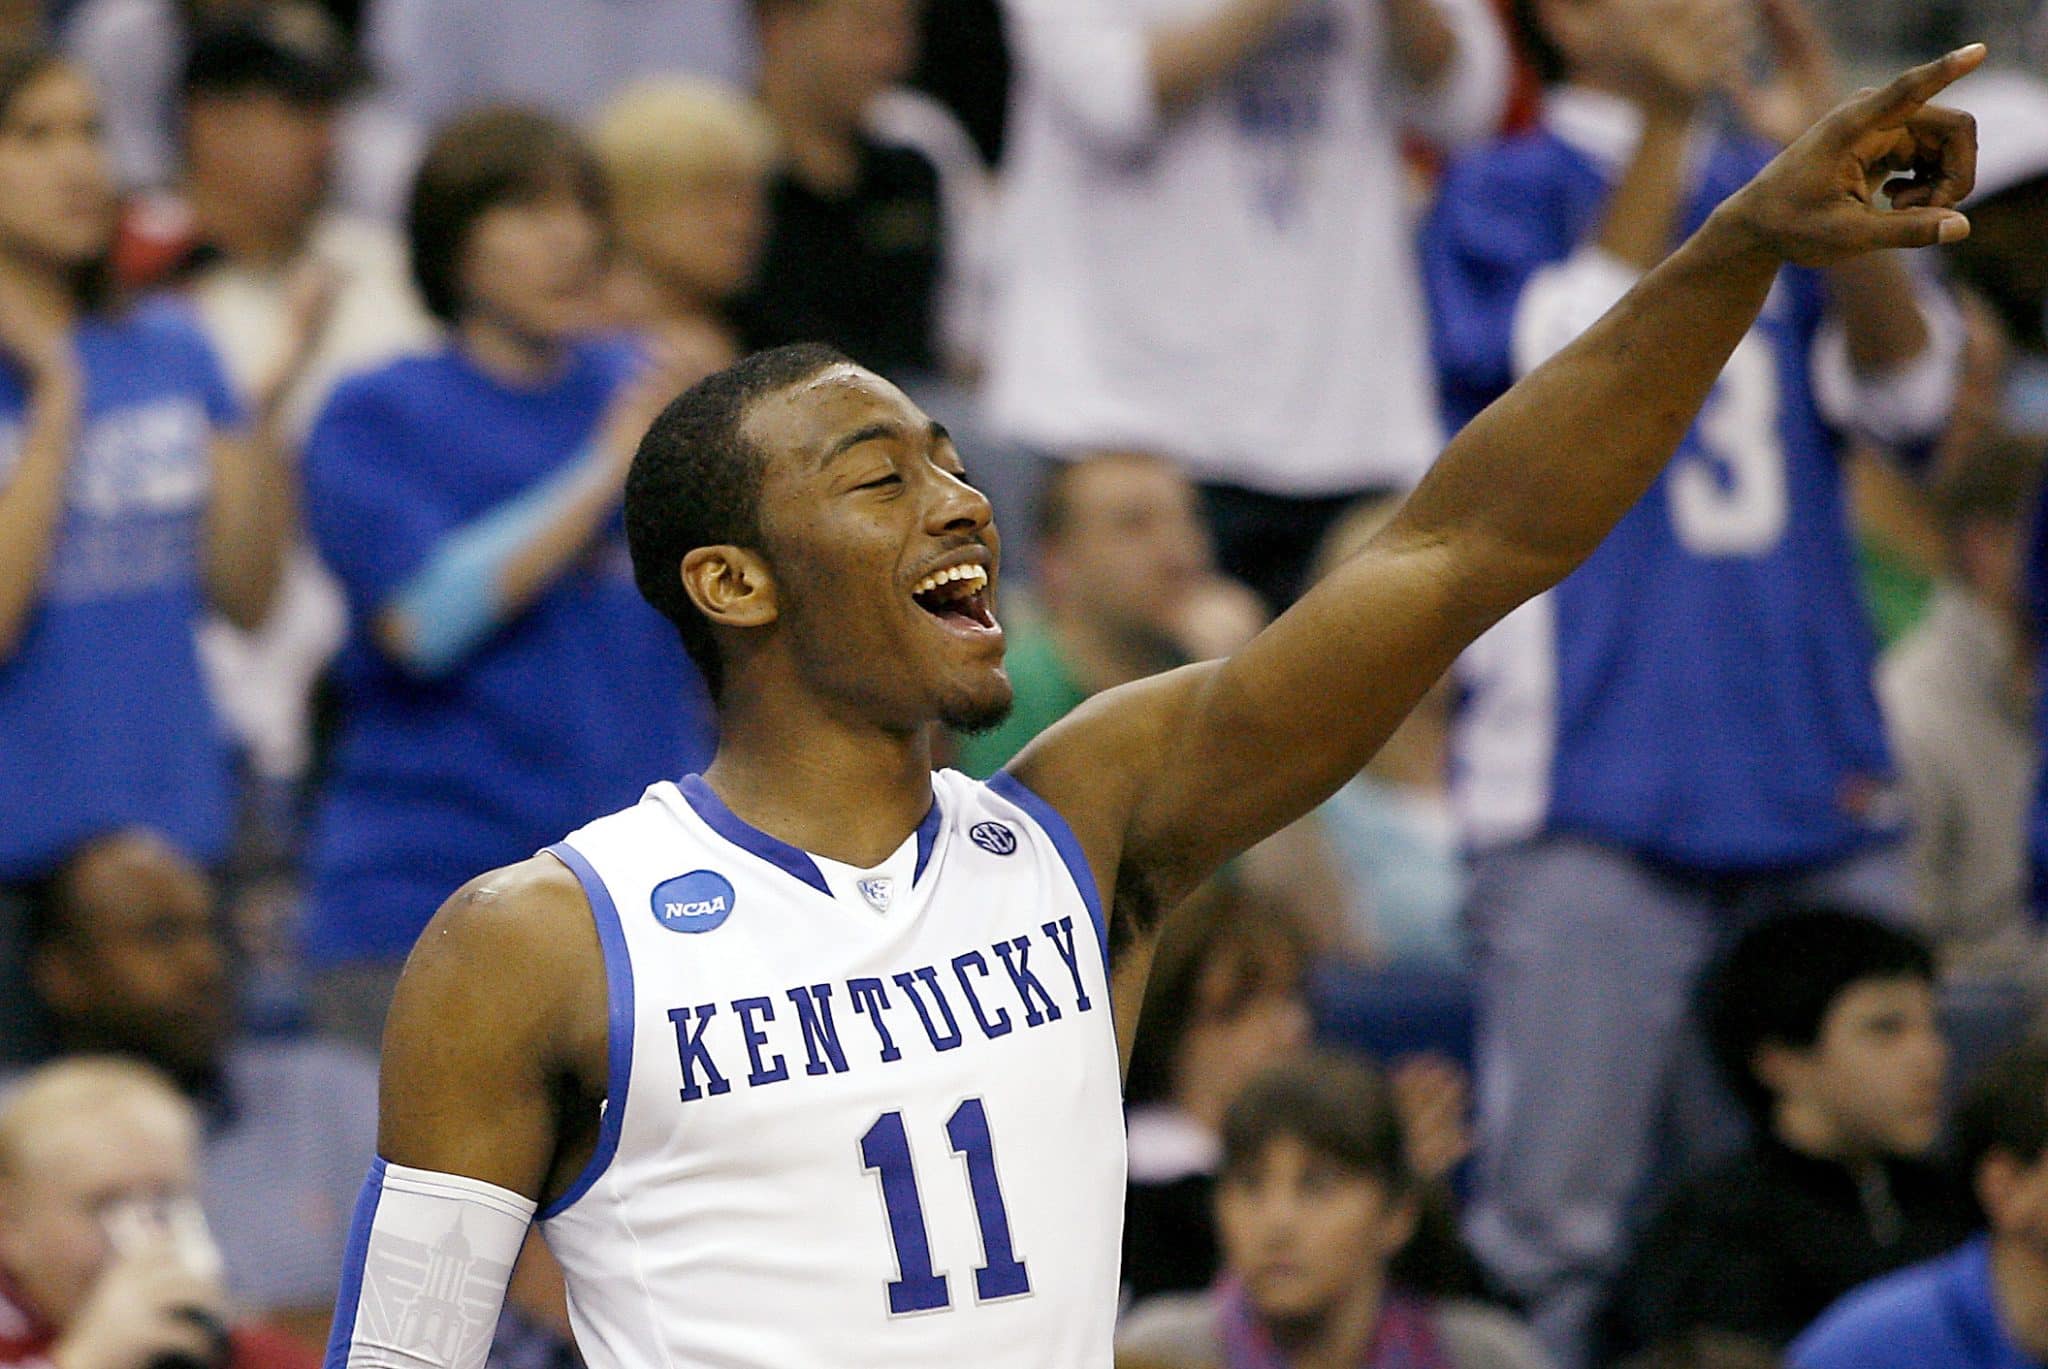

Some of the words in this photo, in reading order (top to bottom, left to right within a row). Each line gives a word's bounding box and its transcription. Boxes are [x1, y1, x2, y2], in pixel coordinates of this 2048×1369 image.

[664, 896, 726, 920] NCAA
[667, 915, 1093, 1102] KENTUCKY
[859, 1096, 1032, 1315] 11
